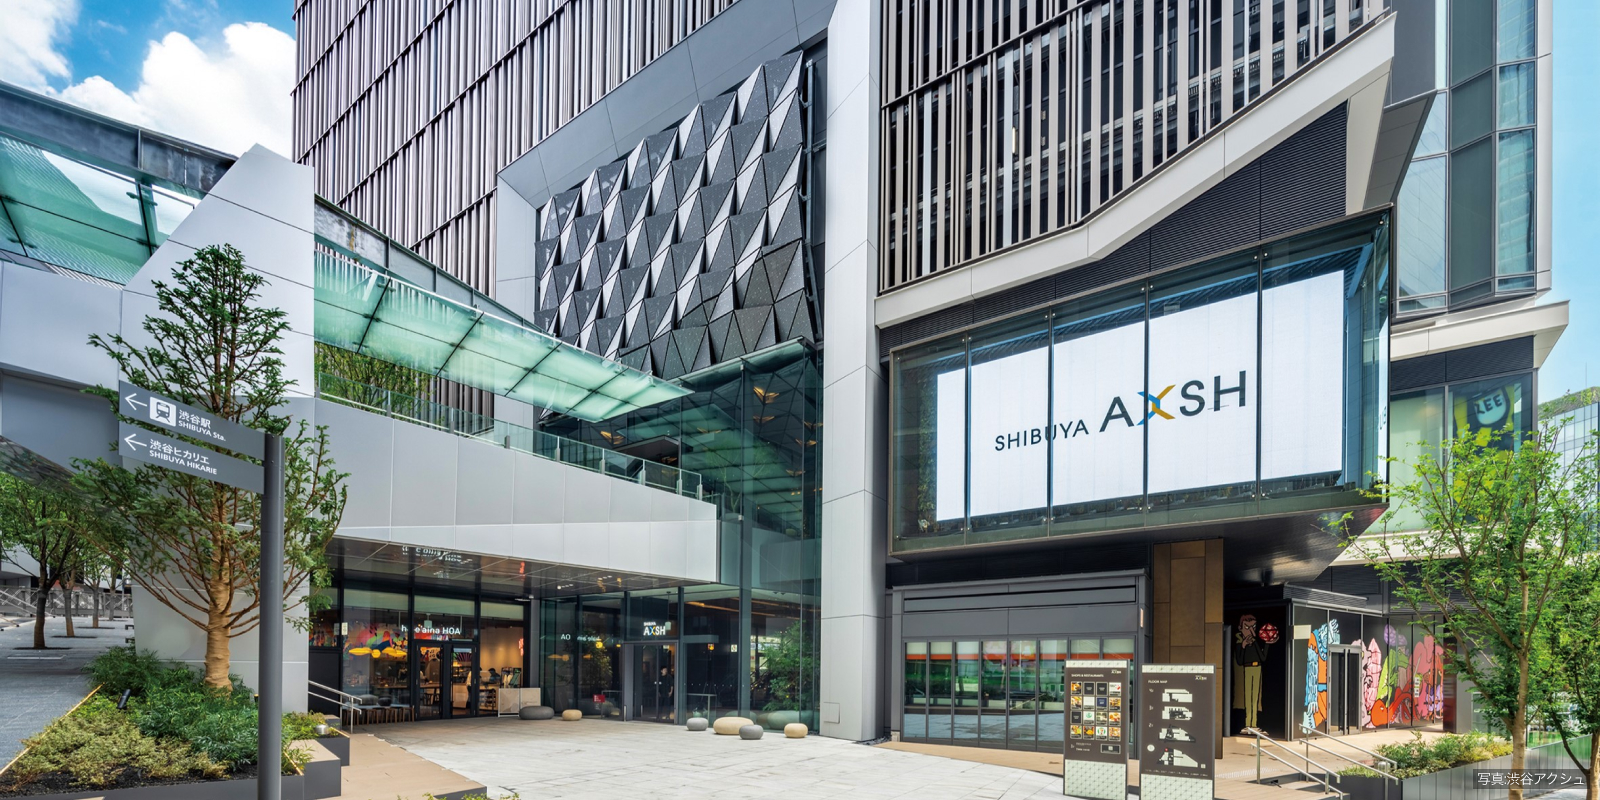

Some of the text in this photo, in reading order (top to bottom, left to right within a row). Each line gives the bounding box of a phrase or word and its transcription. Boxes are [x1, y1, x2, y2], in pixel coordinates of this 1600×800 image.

[179, 409, 211, 430] 渋谷駅
[995, 370, 1247, 452] SHIBUYA AXSH
[178, 420, 227, 442] SHIBUYA Sta.
[149, 450, 218, 475] SHIBUYA HIKARIE
[150, 438, 210, 465] 渋谷ヒカリエ
[442, 626, 461, 635] HOA
[643, 626, 666, 636] AXSH
